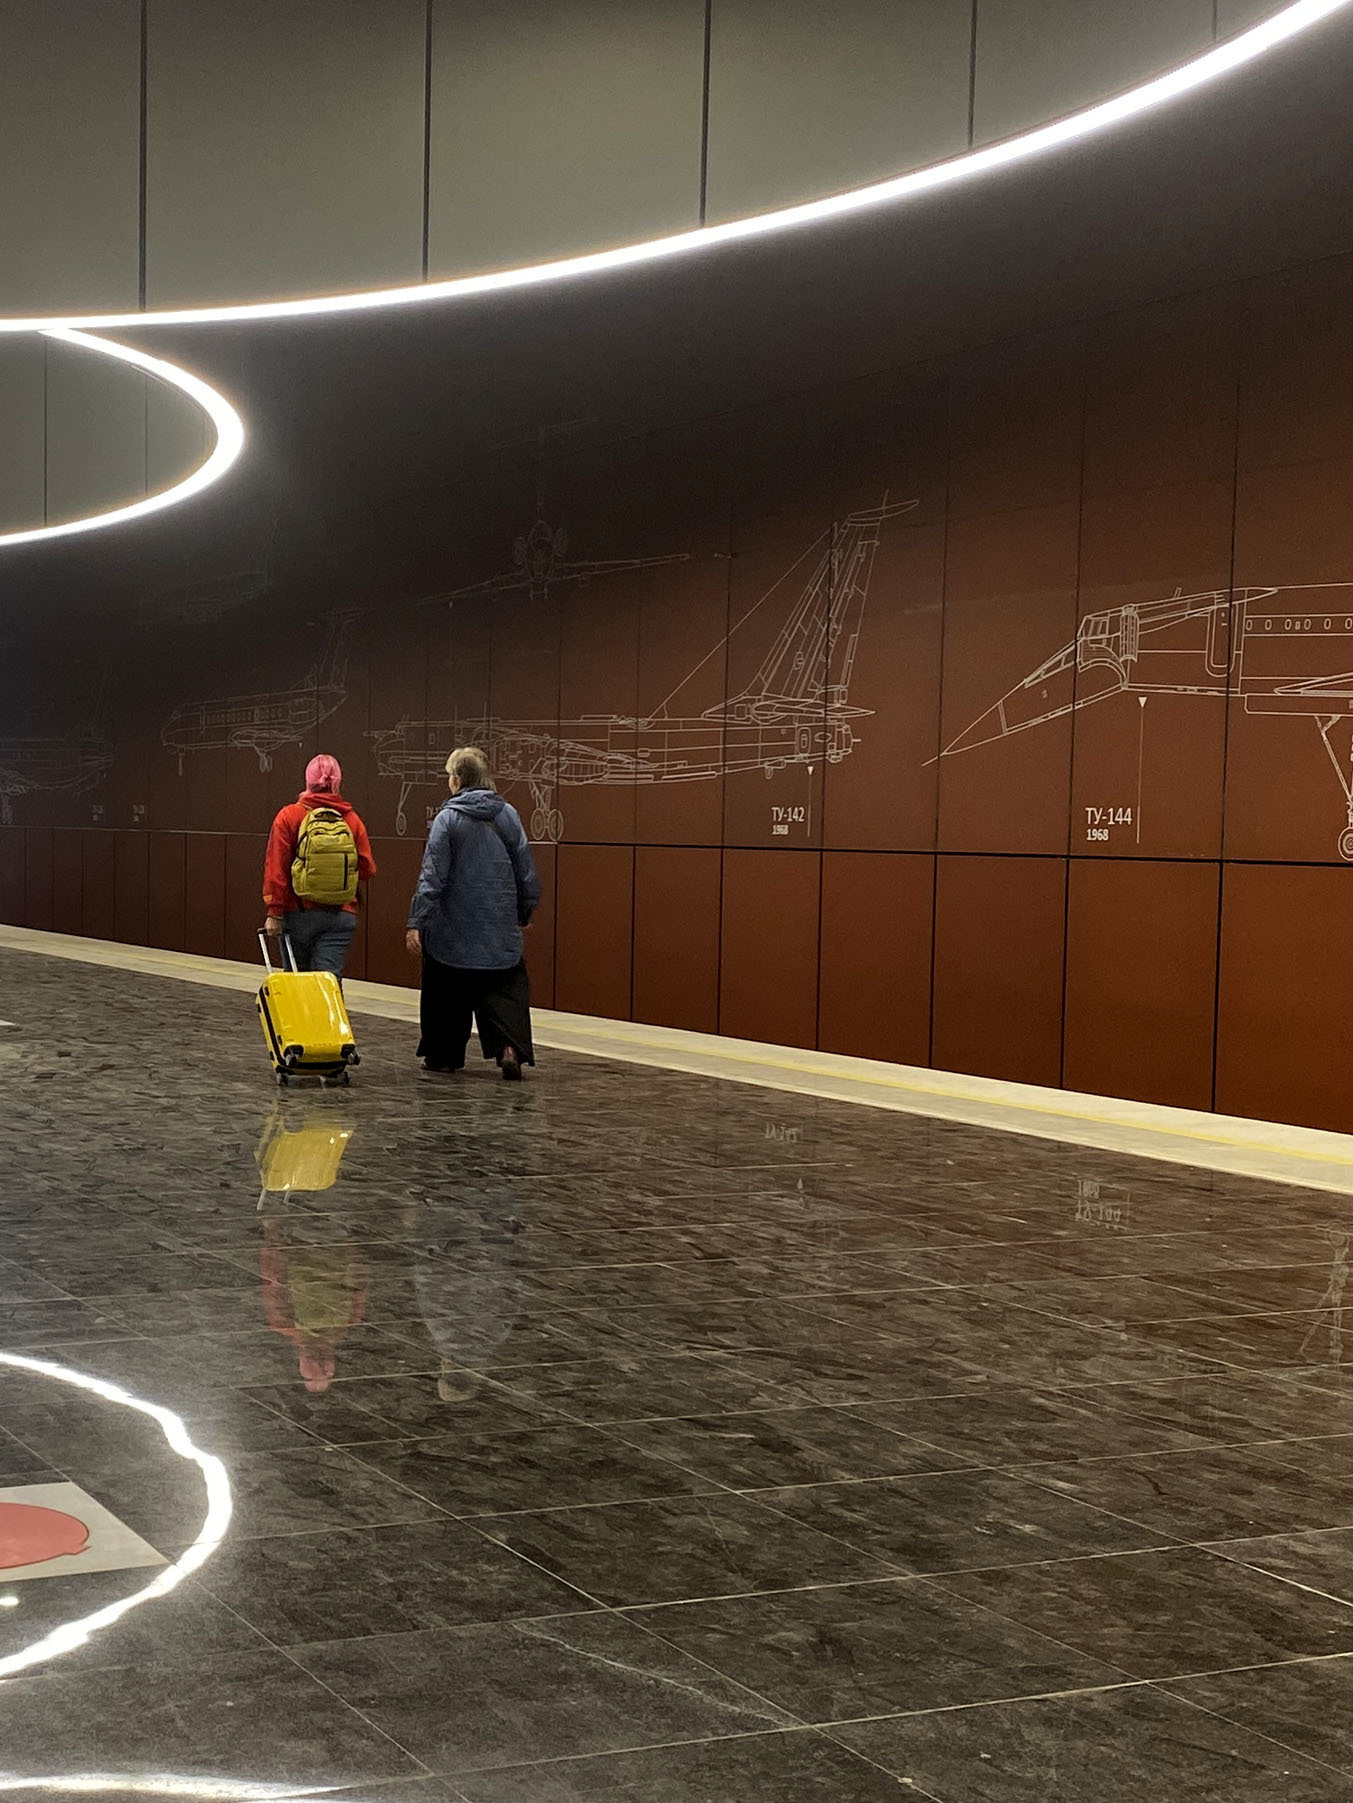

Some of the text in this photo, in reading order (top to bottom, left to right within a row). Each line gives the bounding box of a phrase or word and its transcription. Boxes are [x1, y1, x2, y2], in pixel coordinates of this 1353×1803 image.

[771, 806, 805, 822] ТУ-142
[1085, 807, 1132, 825] ТУ-144
[1086, 828, 1109, 841] 1968
